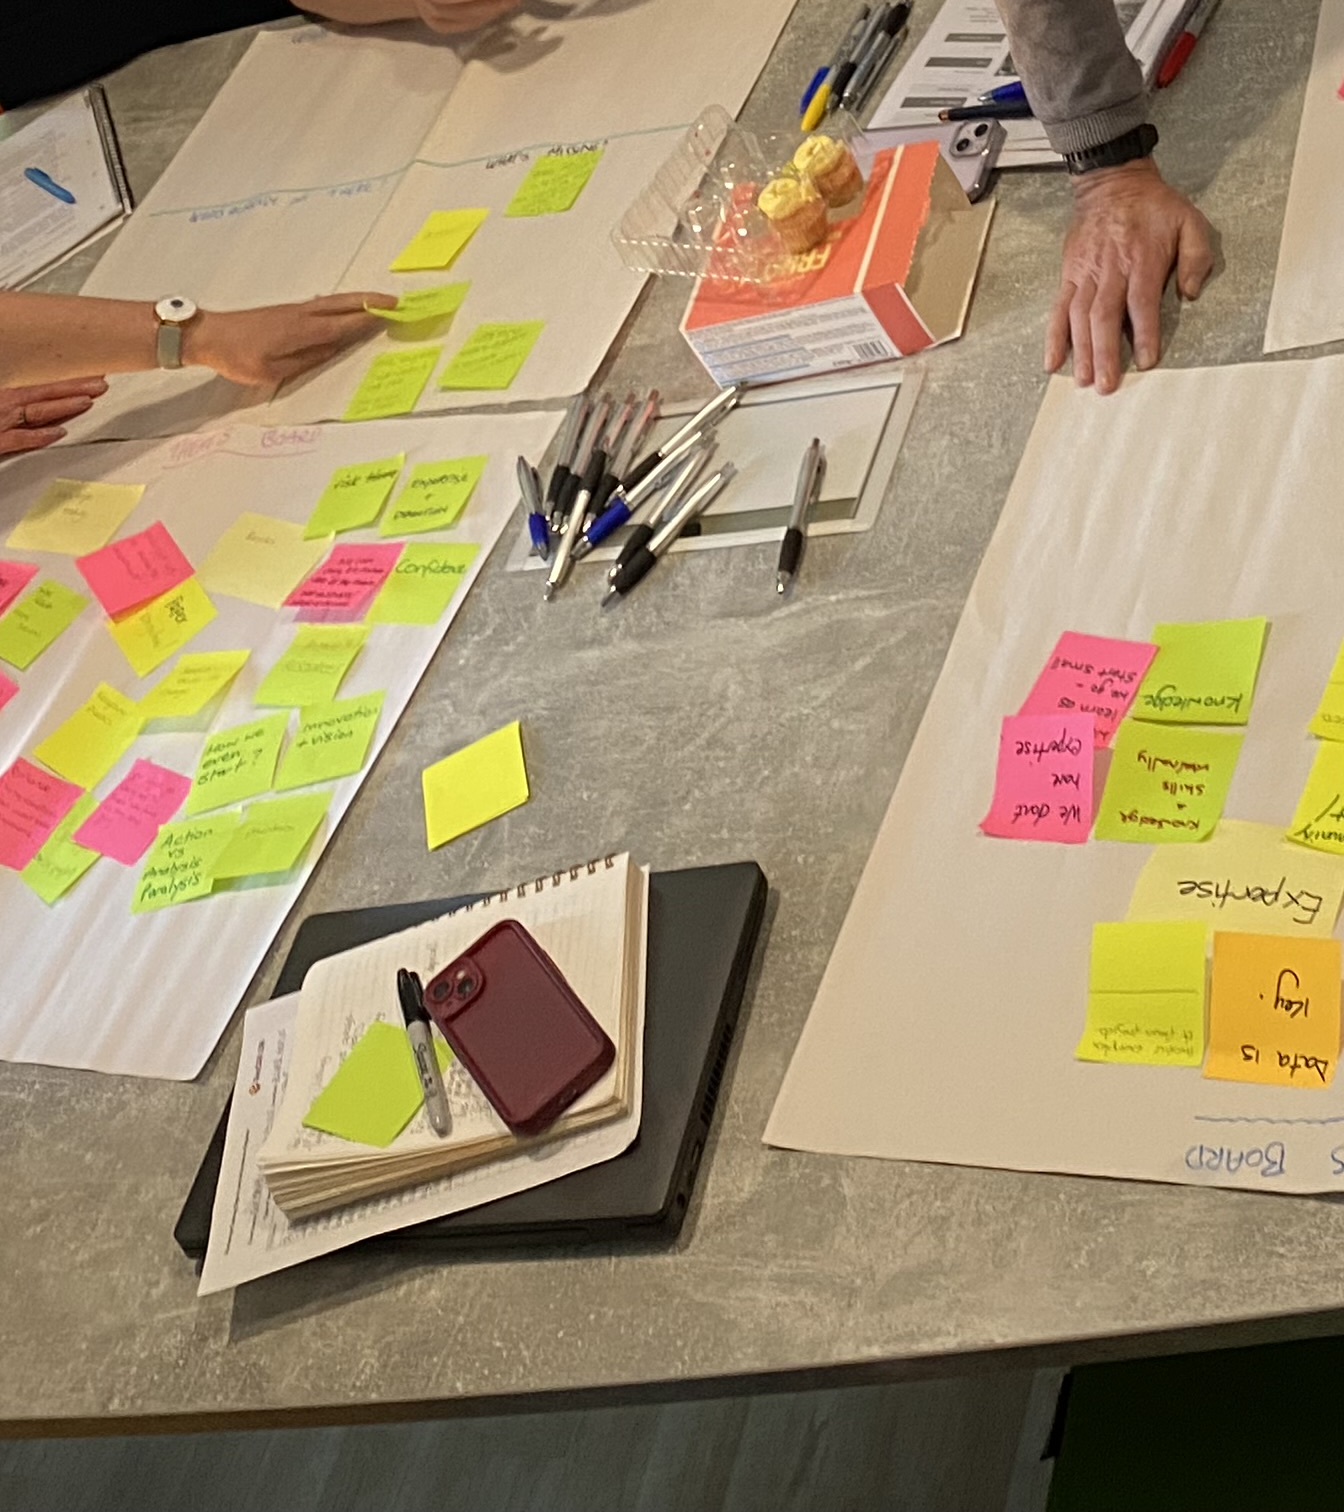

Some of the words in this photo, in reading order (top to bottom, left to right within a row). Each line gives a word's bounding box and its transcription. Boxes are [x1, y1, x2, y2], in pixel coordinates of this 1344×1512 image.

[1057, 697, 1076, 709] as
[1141, 684, 1242, 713] Knowledge
[1080, 702, 1117, 723] learn
[245, 727, 264, 740] we
[1015, 728, 1083, 758] expertise
[202, 749, 240, 769] even
[1051, 773, 1081, 788] have
[1056, 804, 1082, 823] We
[161, 827, 213, 848] Action
[140, 871, 201, 903] Paralysis
[1176, 876, 1323, 924] Expertise
[1277, 1050, 1329, 1082] Data
[1184, 1142, 1285, 1177] BOARD
